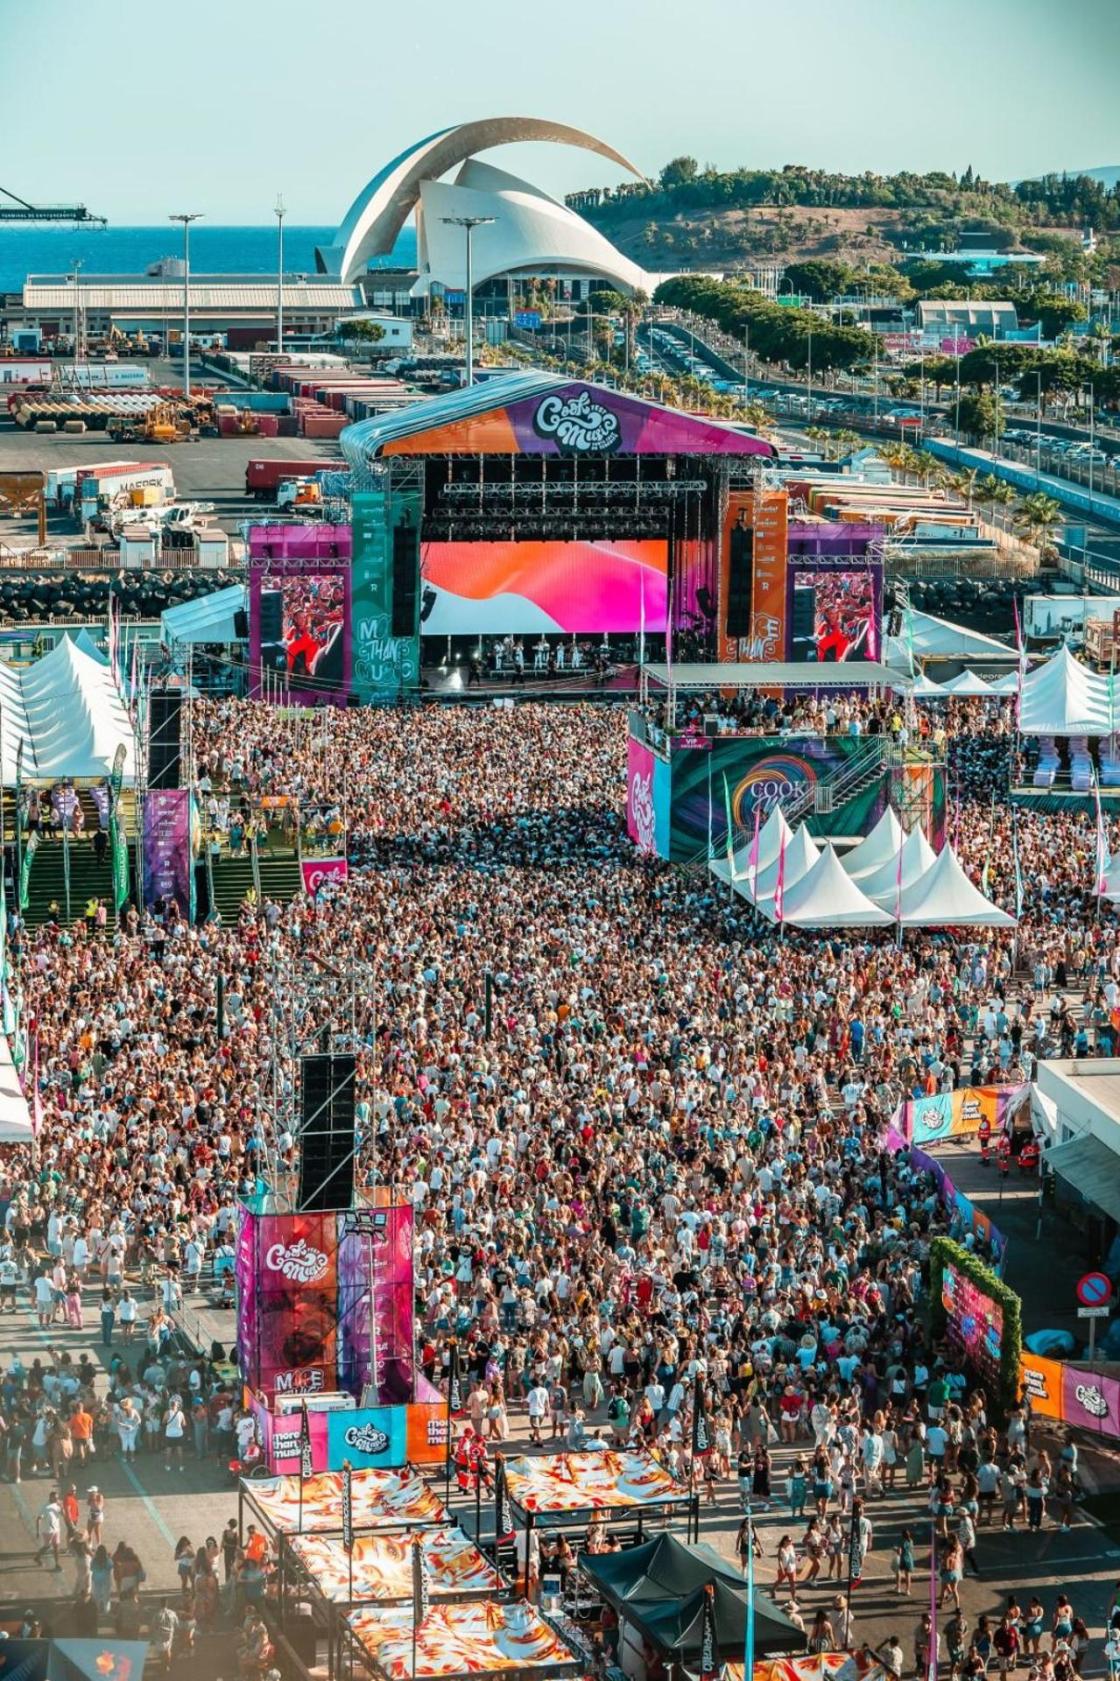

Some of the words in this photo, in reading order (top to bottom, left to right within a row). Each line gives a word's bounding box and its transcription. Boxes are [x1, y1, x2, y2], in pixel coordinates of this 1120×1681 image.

[537, 391, 601, 431] Cook
[557, 413, 618, 450] Music
[751, 781, 806, 798] COOK
[266, 1239, 317, 1271] Cook
[282, 1253, 328, 1282] Music
[273, 1431, 300, 1441] more
[428, 1427, 447, 1435] tha
